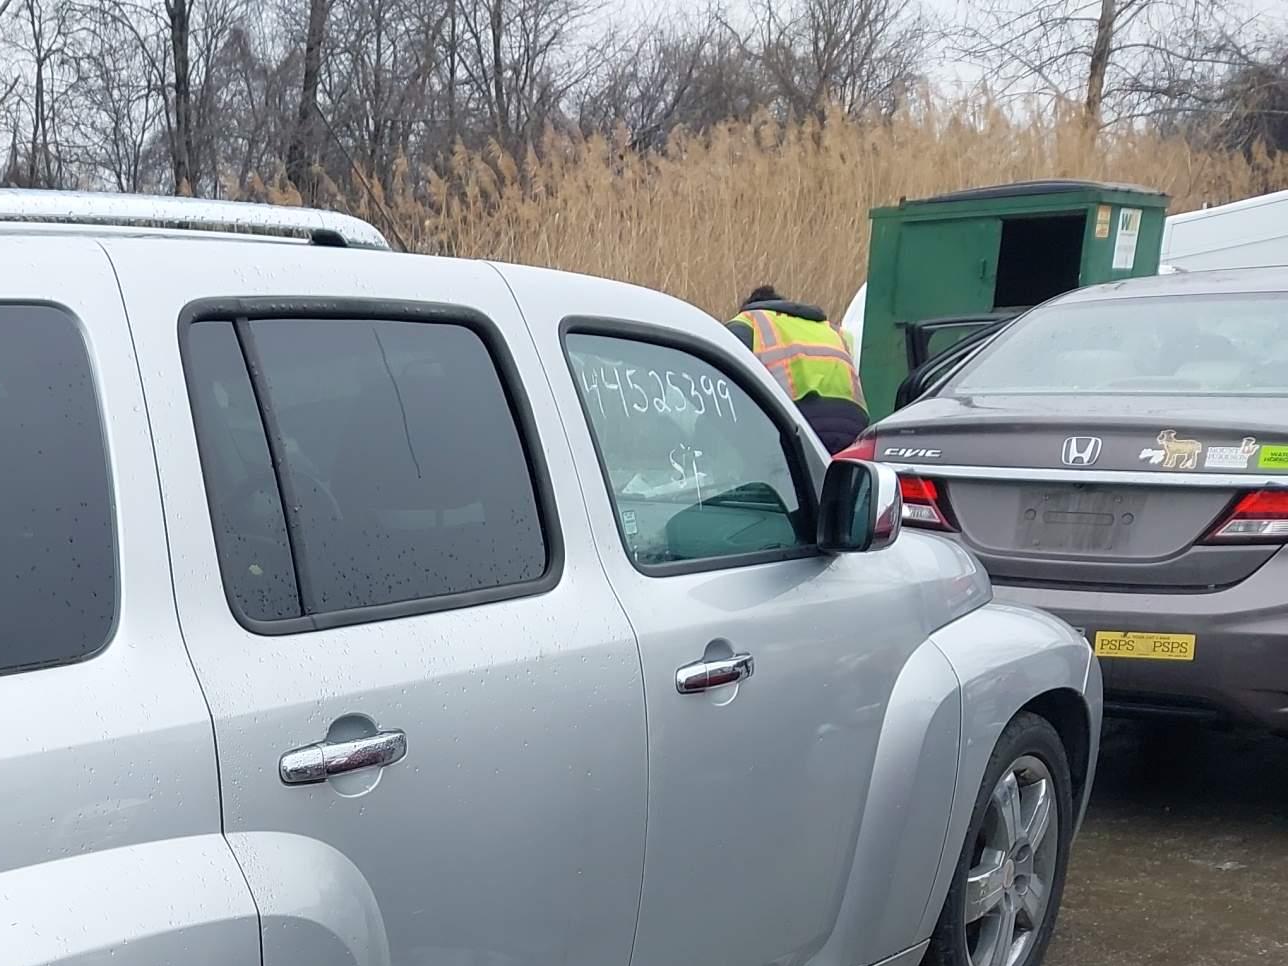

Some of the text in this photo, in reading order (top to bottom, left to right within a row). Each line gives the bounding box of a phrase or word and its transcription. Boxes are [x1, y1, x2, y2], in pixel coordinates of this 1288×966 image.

[582, 368, 737, 422] 44525399
[884, 448, 942, 458] CIVIC
[1100, 638, 1188, 654] PSPS PSPS
